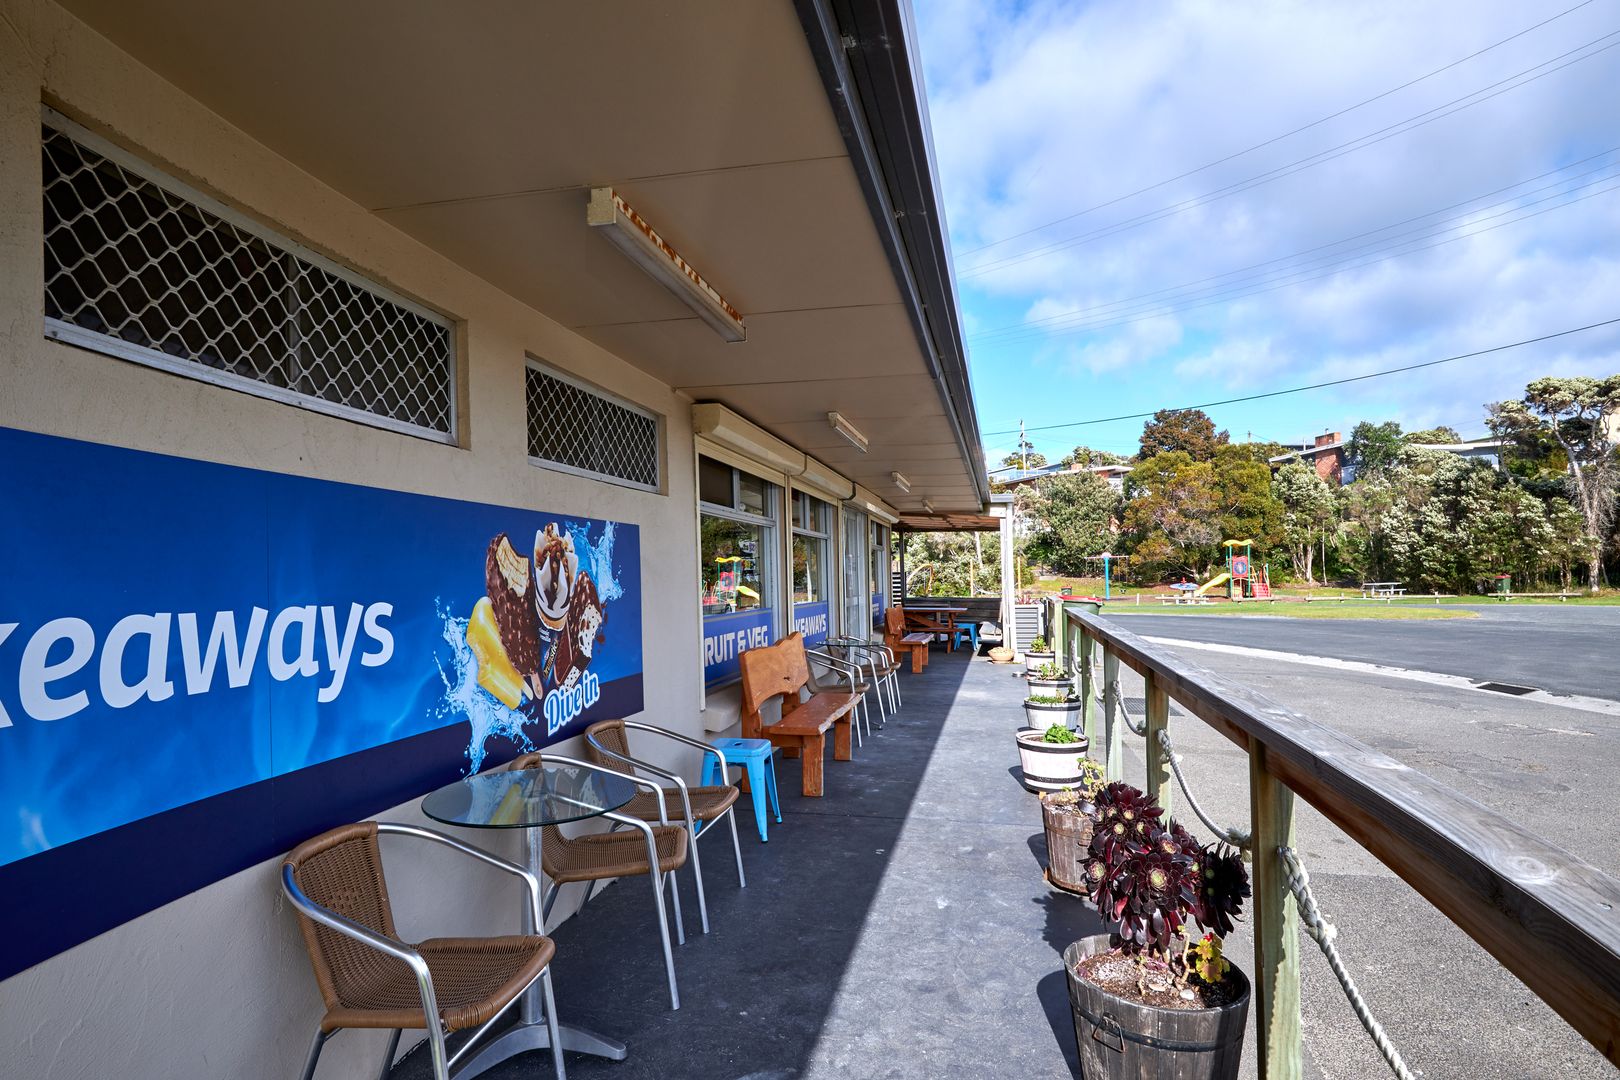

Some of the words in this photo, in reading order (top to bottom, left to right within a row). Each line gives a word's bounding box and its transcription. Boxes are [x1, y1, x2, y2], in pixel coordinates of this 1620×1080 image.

[0, 601, 395, 729] eaways
[704, 632, 736, 667] RUIT
[737, 630, 747, 654] &
[747, 625, 769, 649] VEG
[544, 683, 583, 737] Dive
[582, 669, 600, 709] in
